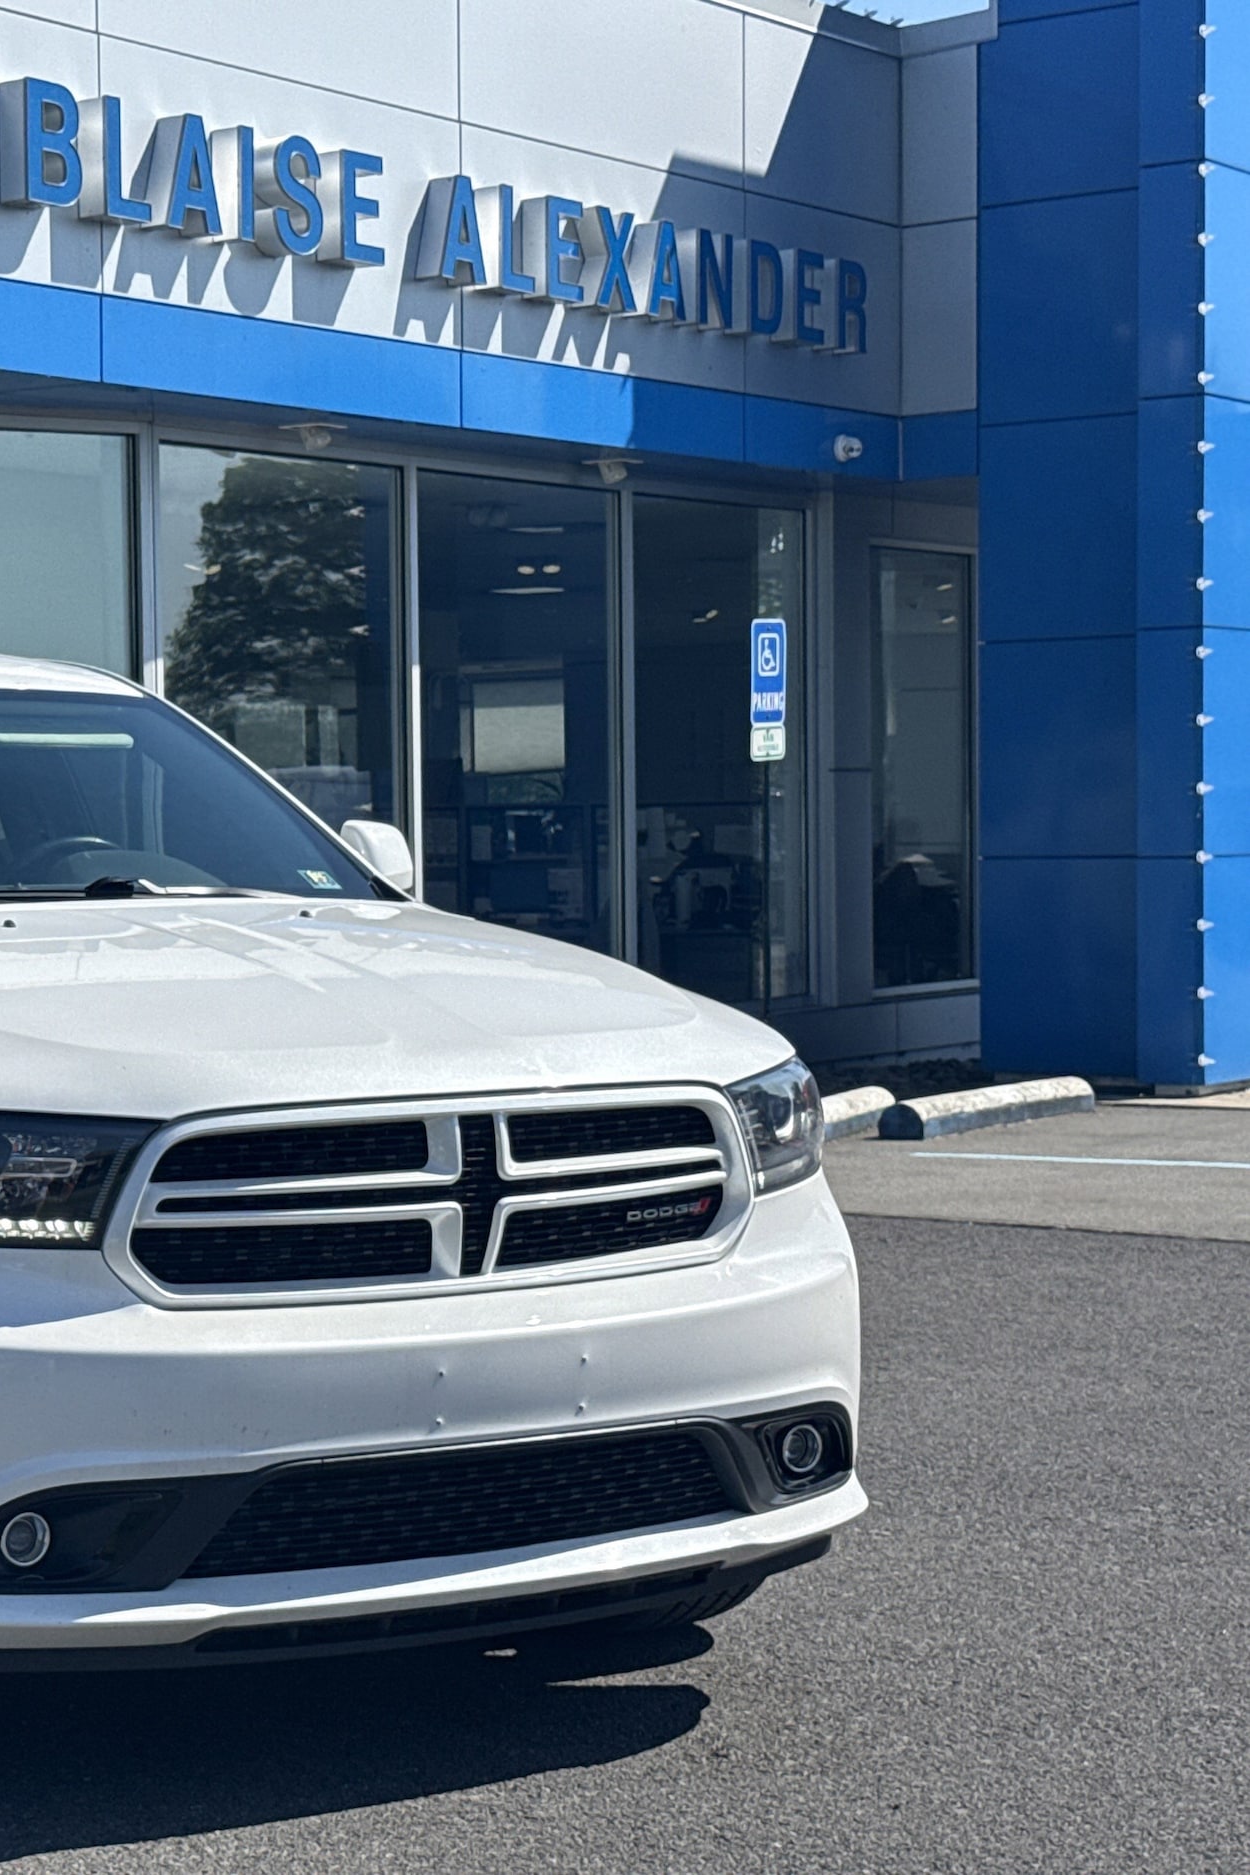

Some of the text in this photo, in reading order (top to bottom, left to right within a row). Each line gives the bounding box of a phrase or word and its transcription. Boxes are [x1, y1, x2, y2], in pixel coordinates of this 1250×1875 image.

[23, 77, 868, 354] BLAISE ALEXANDER
[752, 692, 784, 712] PARKING
[626, 1201, 700, 1221] DODGE
